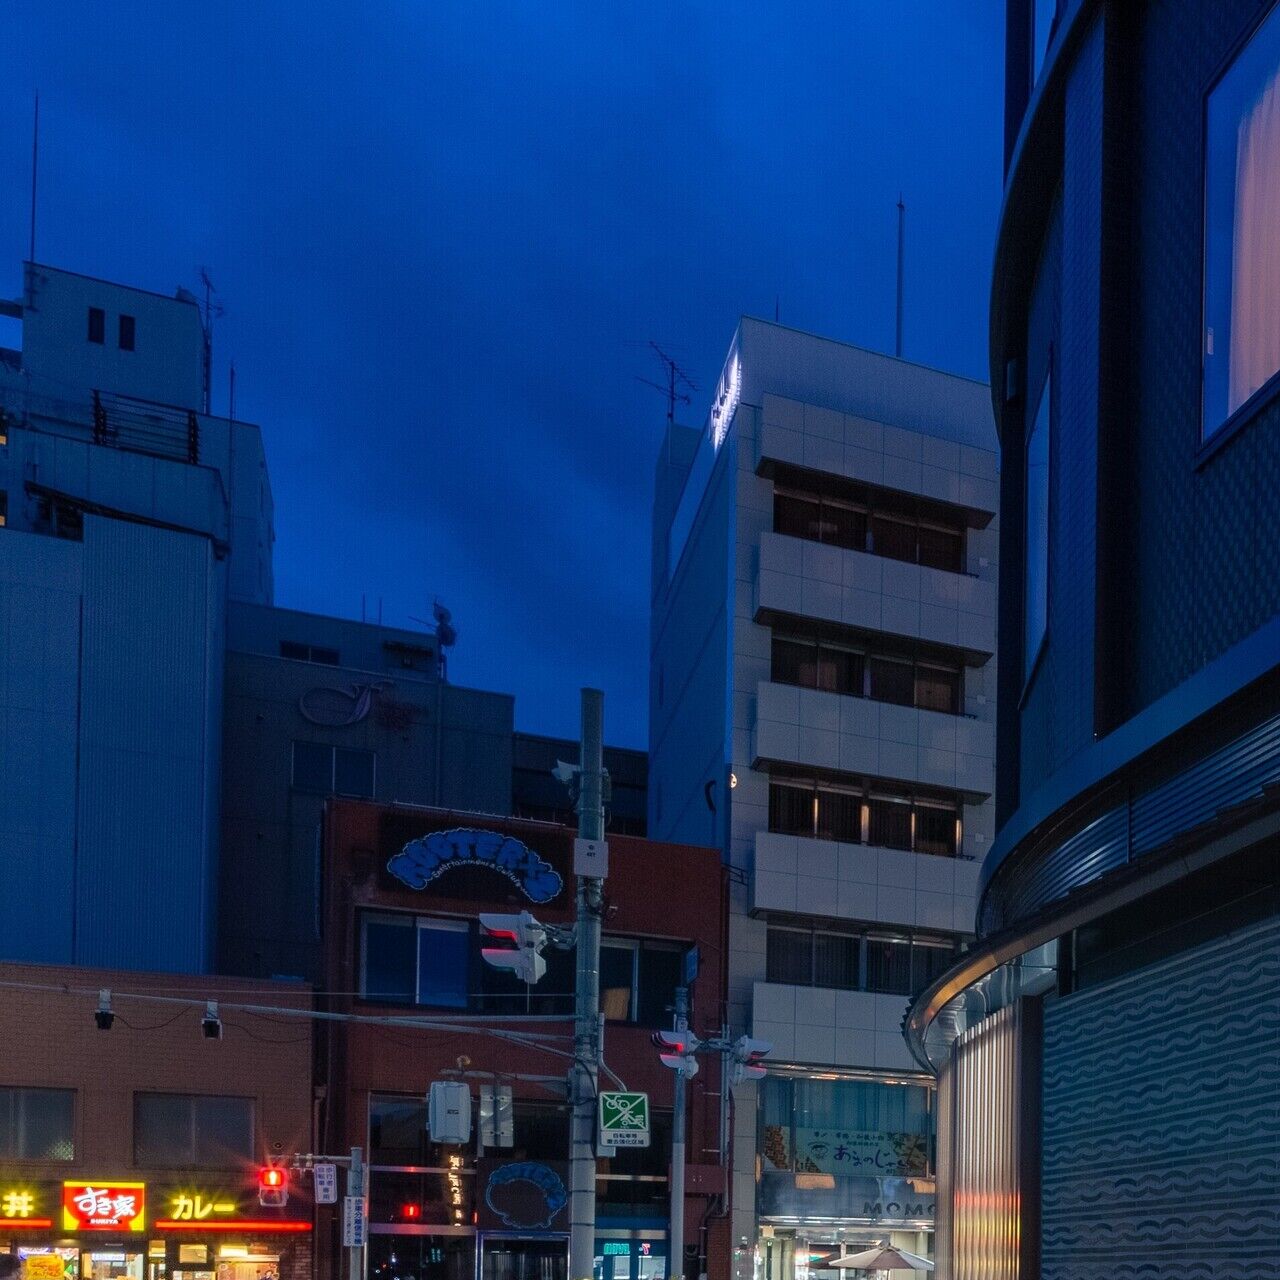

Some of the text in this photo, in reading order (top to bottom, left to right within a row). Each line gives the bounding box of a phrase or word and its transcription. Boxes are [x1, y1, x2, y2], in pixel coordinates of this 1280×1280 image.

[73, 1187, 136, 1219] すき家
[172, 1194, 236, 1220] カレー
